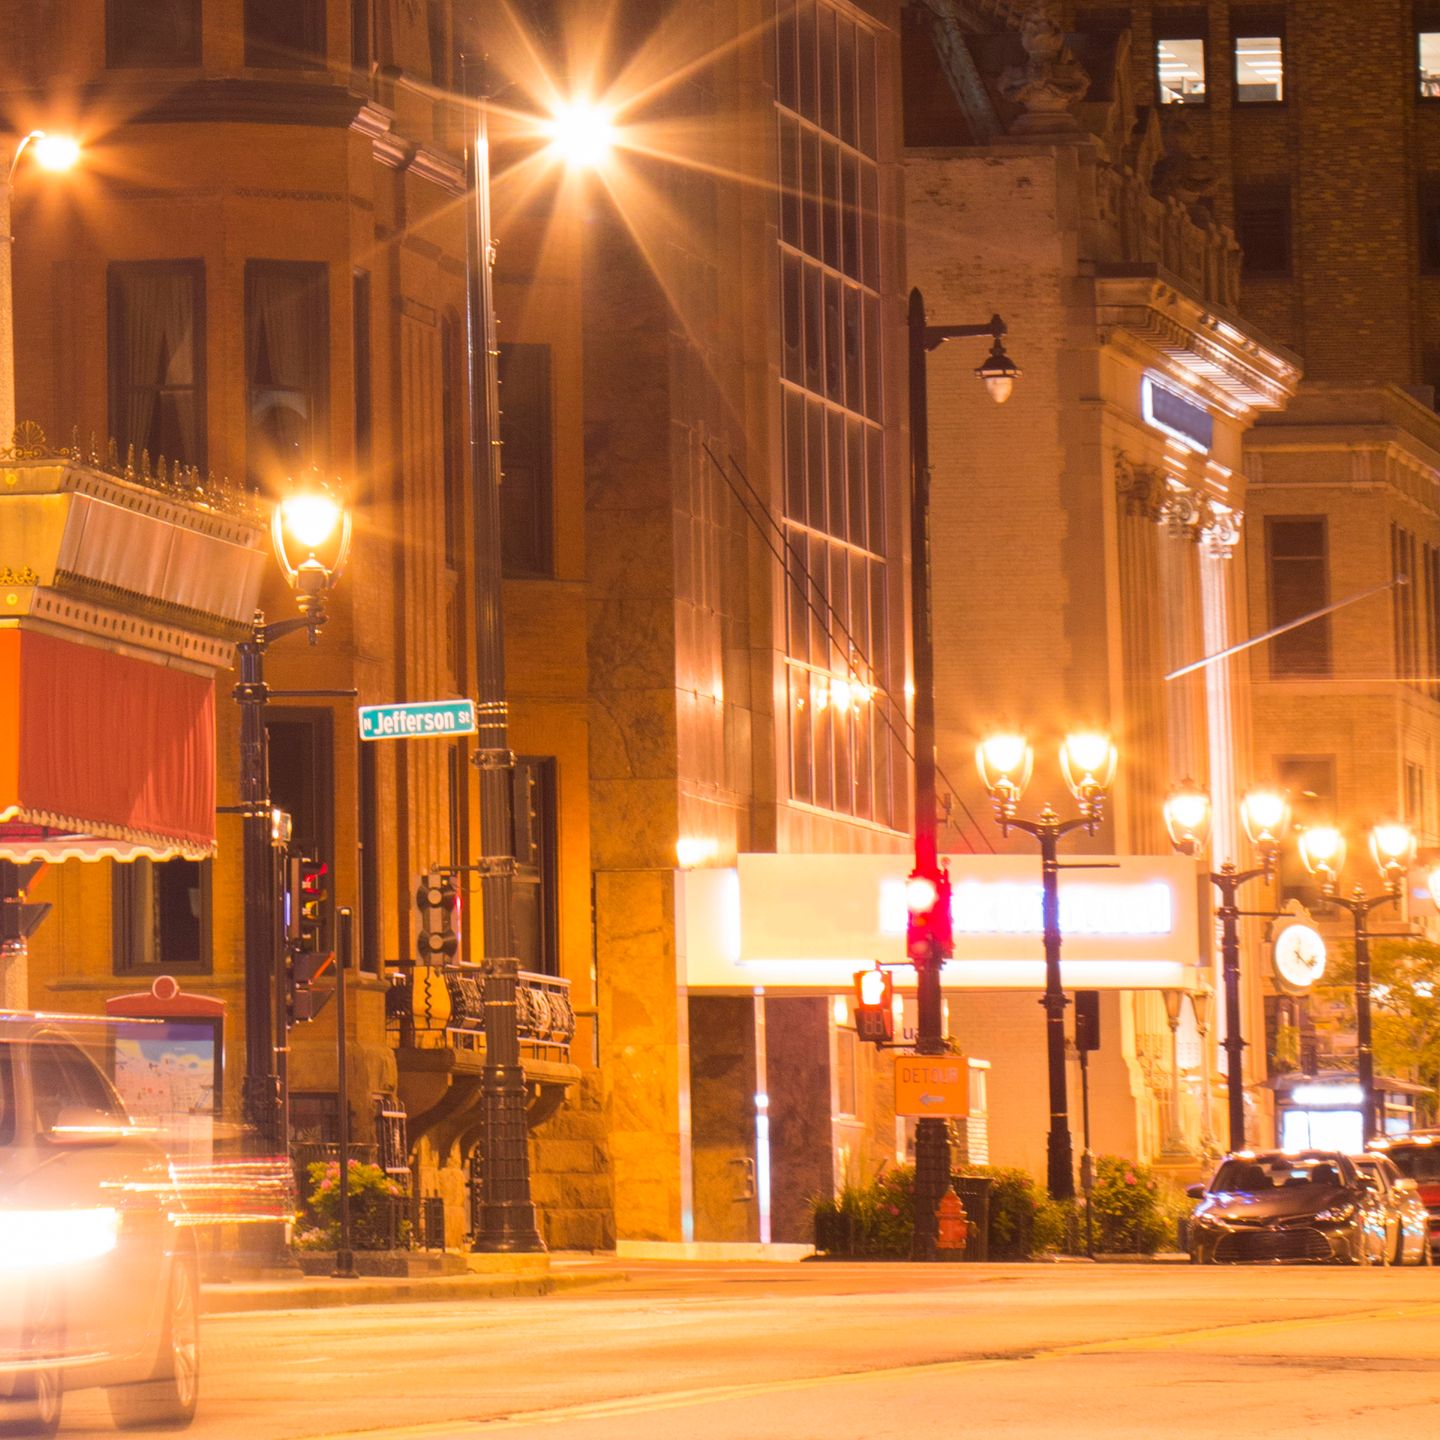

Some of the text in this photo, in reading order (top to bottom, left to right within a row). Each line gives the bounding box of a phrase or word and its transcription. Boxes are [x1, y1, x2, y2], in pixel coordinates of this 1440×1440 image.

[363, 710, 470, 735] N Jefferson St
[902, 1068, 958, 1084] DETOUR
